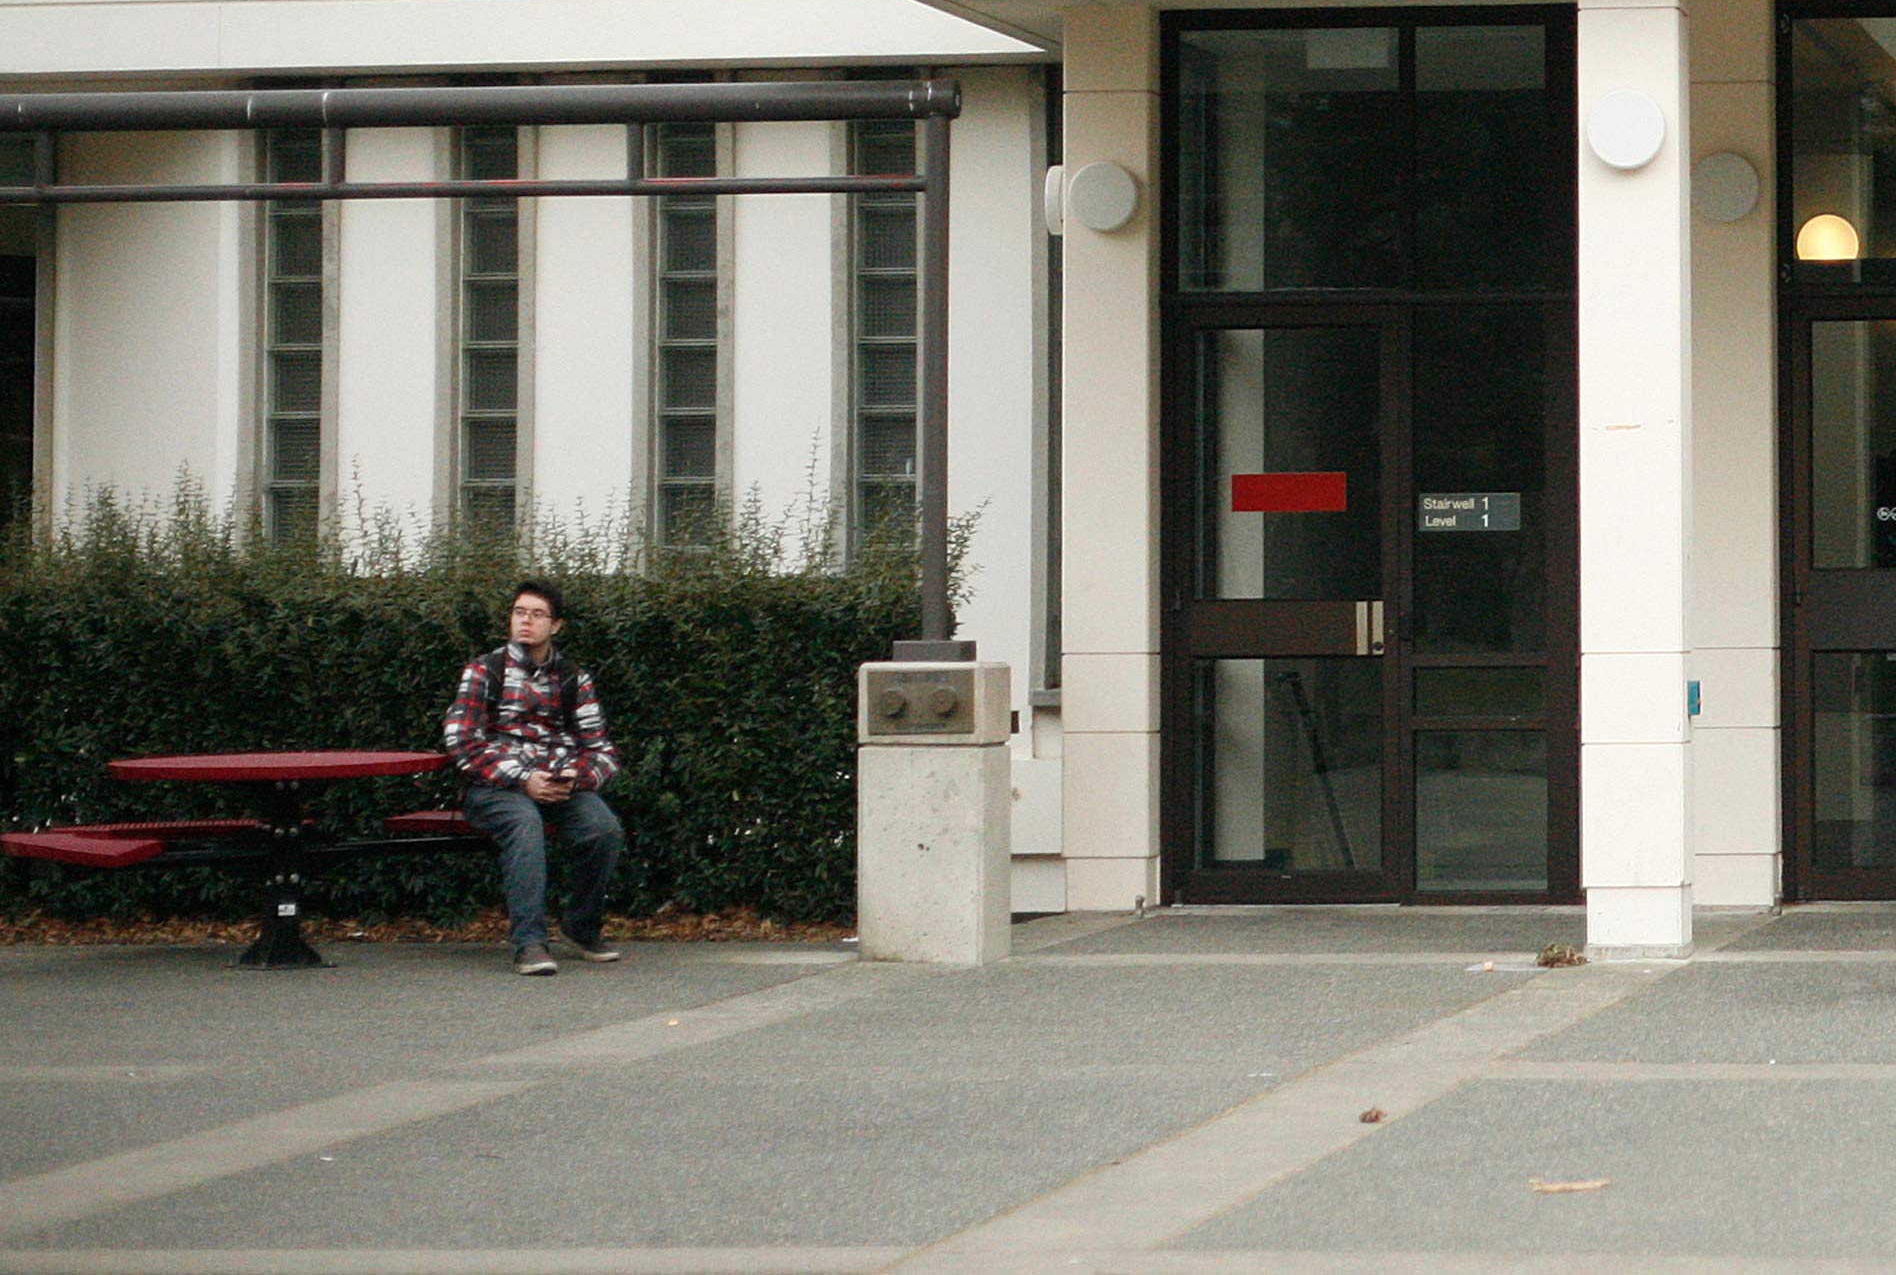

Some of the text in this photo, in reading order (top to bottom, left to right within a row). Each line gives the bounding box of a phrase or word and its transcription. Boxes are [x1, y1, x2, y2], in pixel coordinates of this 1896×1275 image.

[1423, 496, 1489, 511] Stairwell 1
[1425, 513, 1489, 528] Level 1
